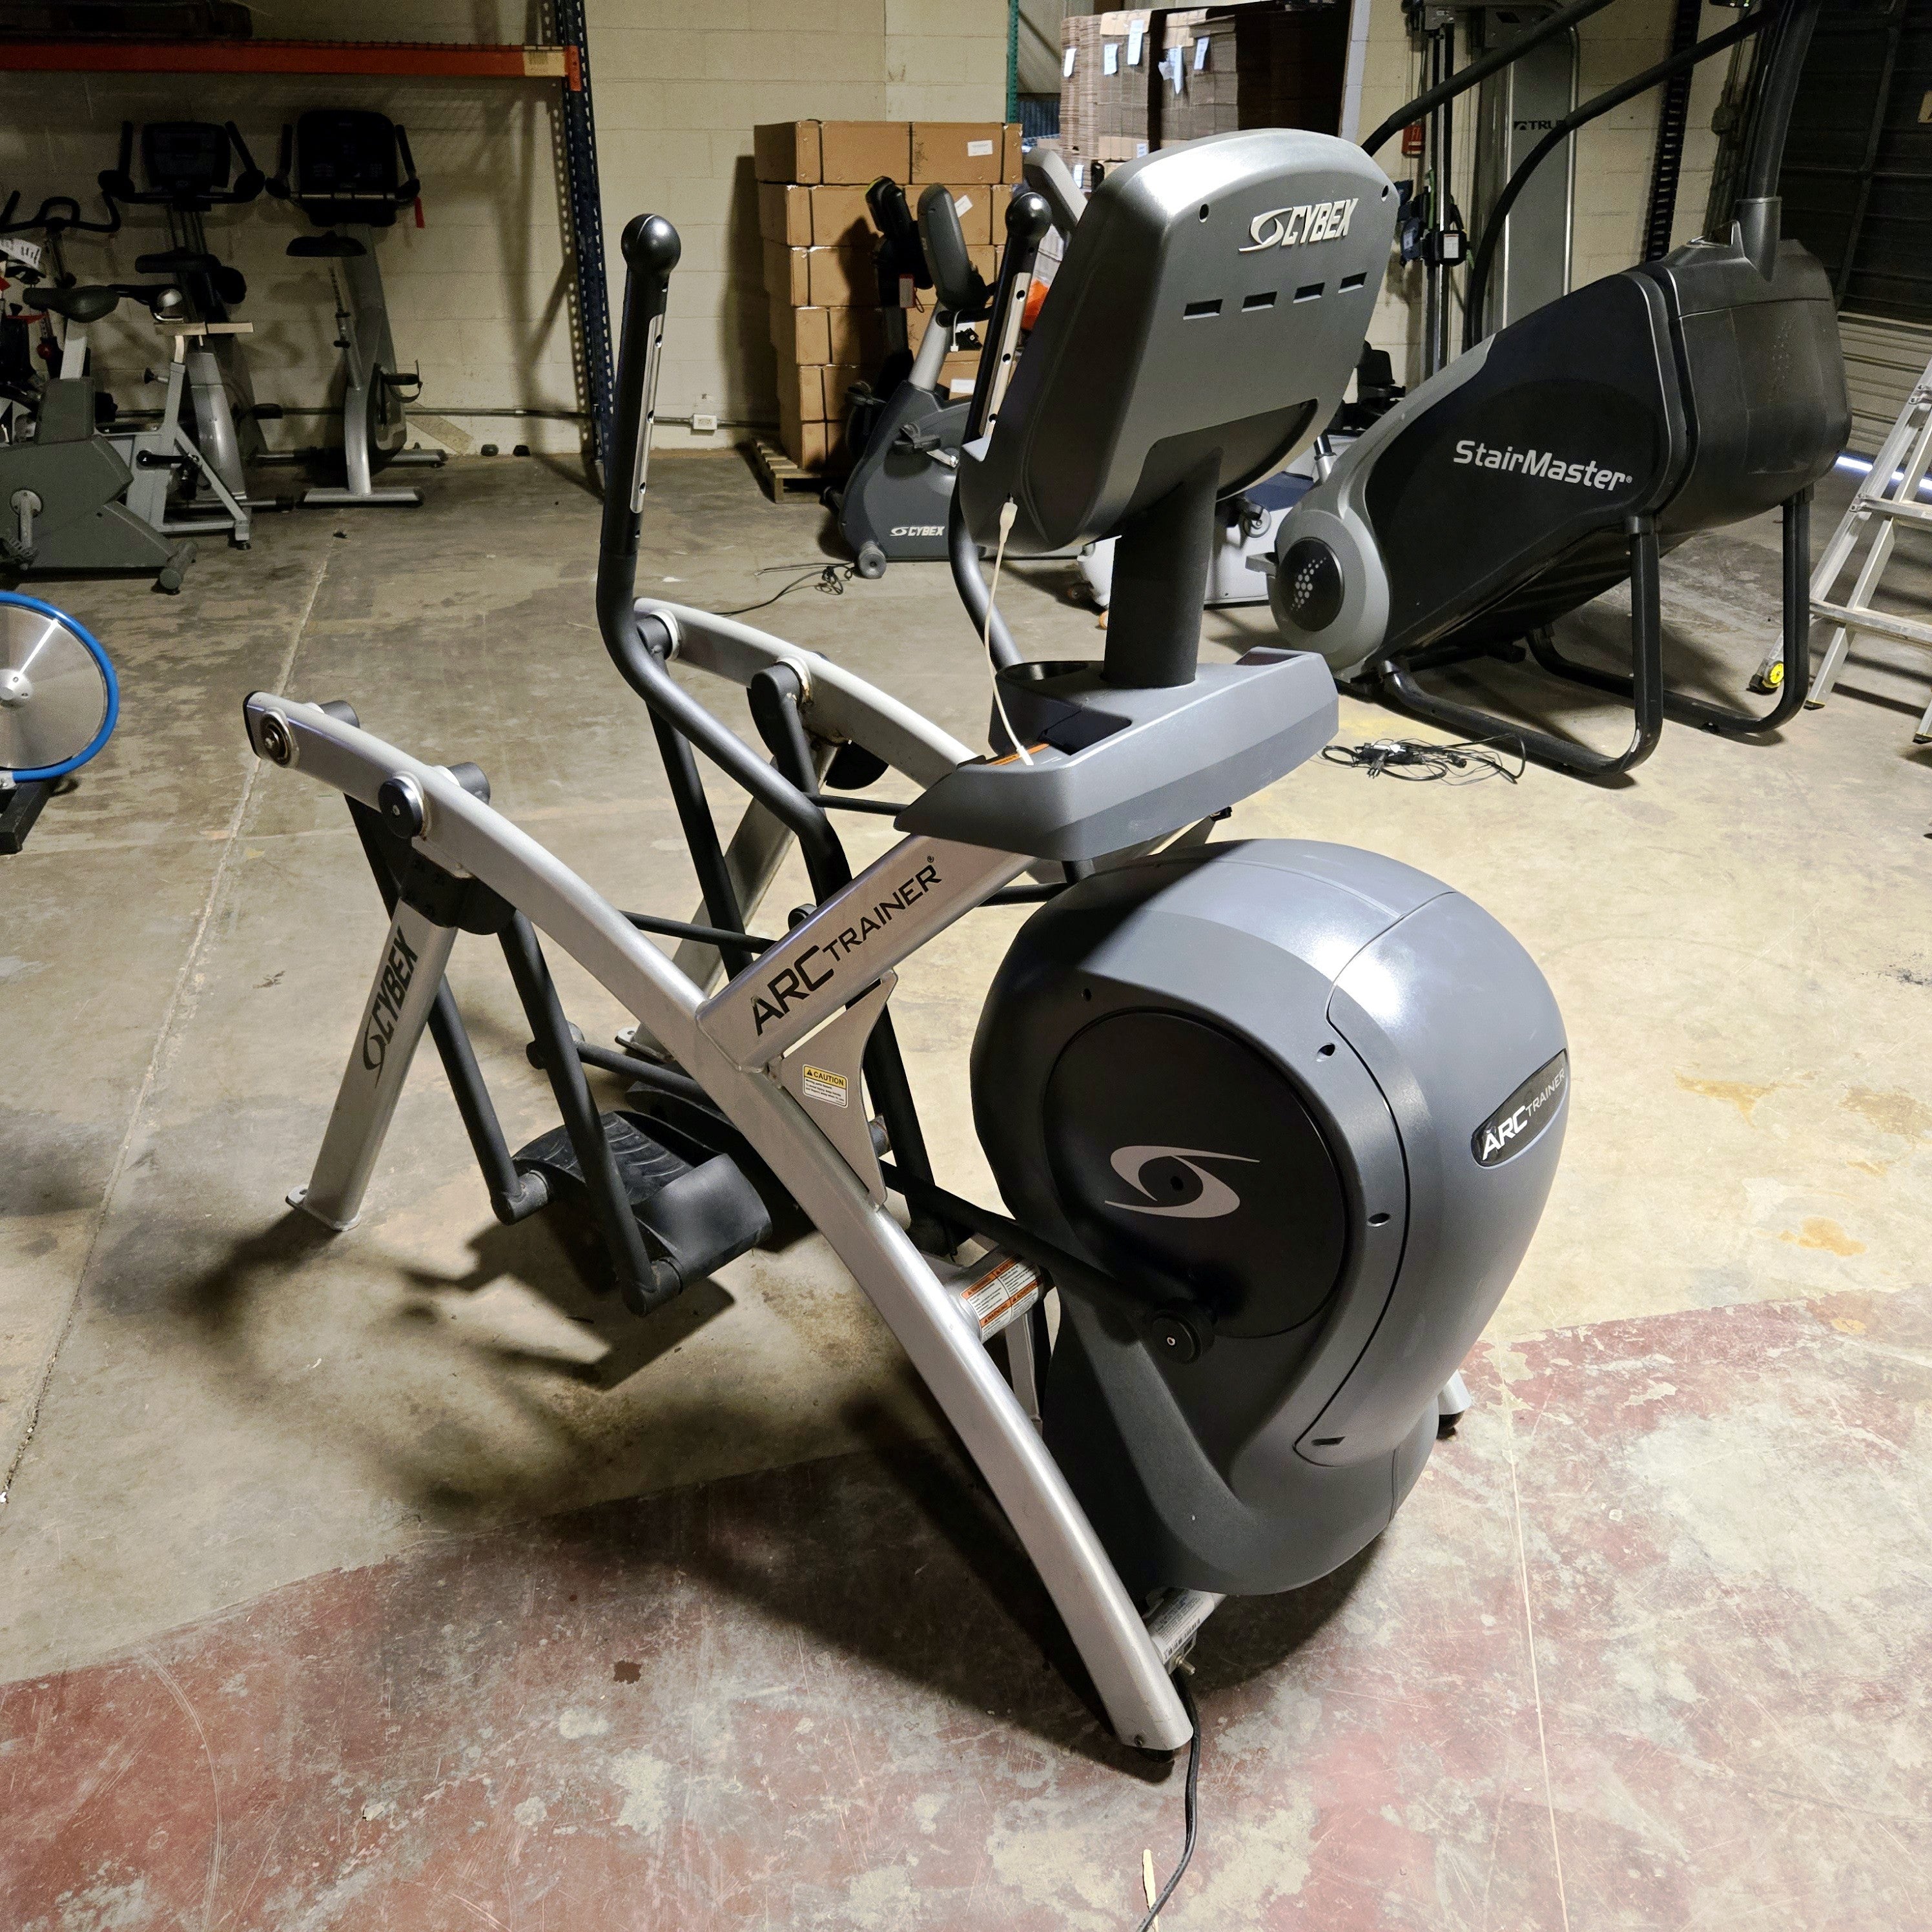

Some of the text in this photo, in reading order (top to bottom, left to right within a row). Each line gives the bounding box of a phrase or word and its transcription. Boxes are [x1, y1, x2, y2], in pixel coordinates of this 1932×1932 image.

[1528, 119, 1565, 130] TRU
[1281, 198, 1359, 246] CYBEX
[907, 526, 945, 536] CYBEX
[371, 924, 418, 1044] CYBEX
[750, 945, 834, 1036] ARC
[814, 1071, 844, 1086] CAUTION
[1482, 1067, 1565, 1161] ARC TRAINER
